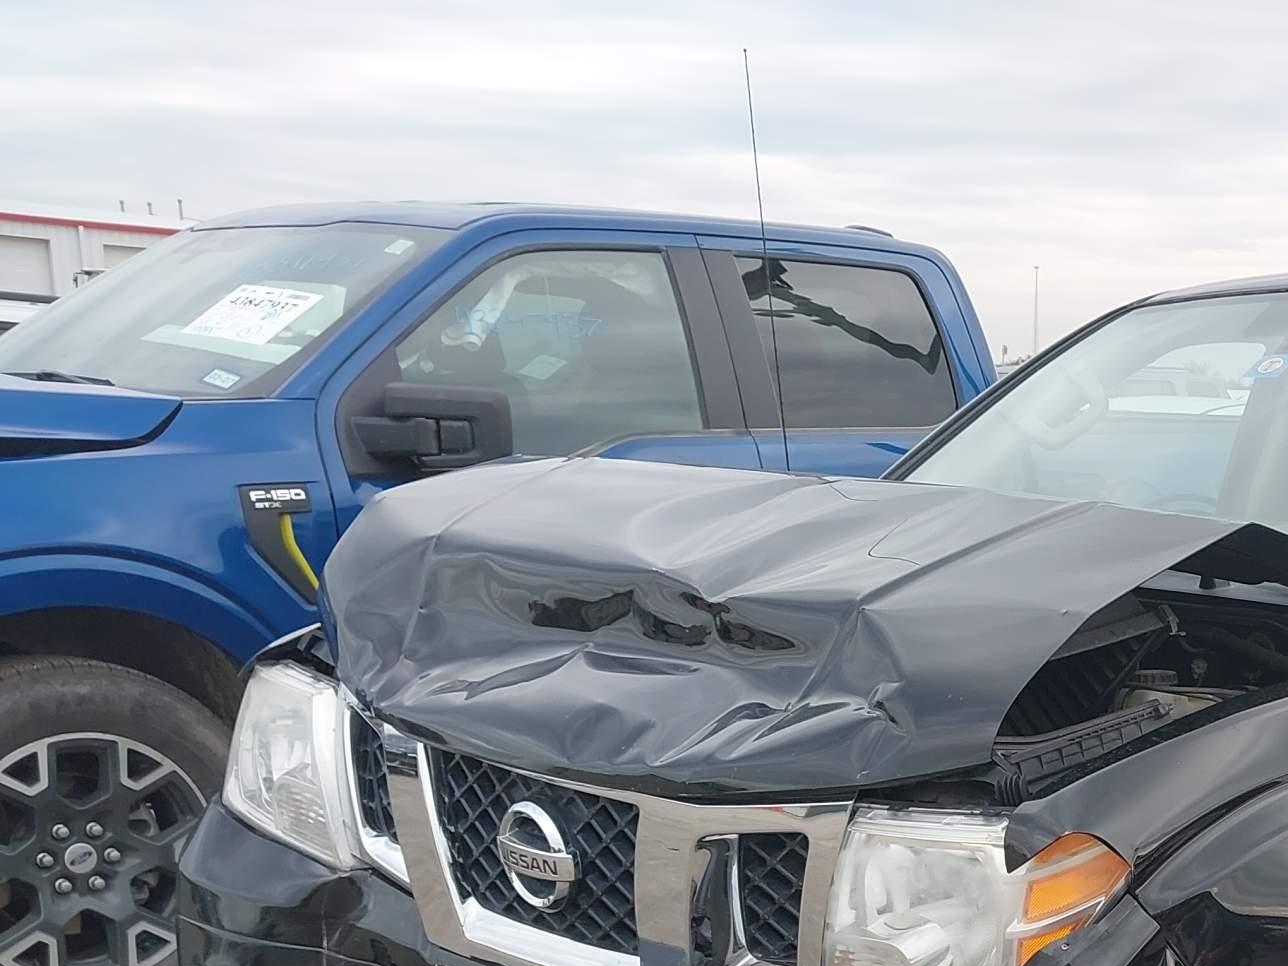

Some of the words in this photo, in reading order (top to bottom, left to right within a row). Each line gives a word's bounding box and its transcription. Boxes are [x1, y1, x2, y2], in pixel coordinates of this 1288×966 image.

[249, 488, 307, 502] F-150
[254, 501, 283, 510] STX
[501, 846, 560, 877] NISSAN
